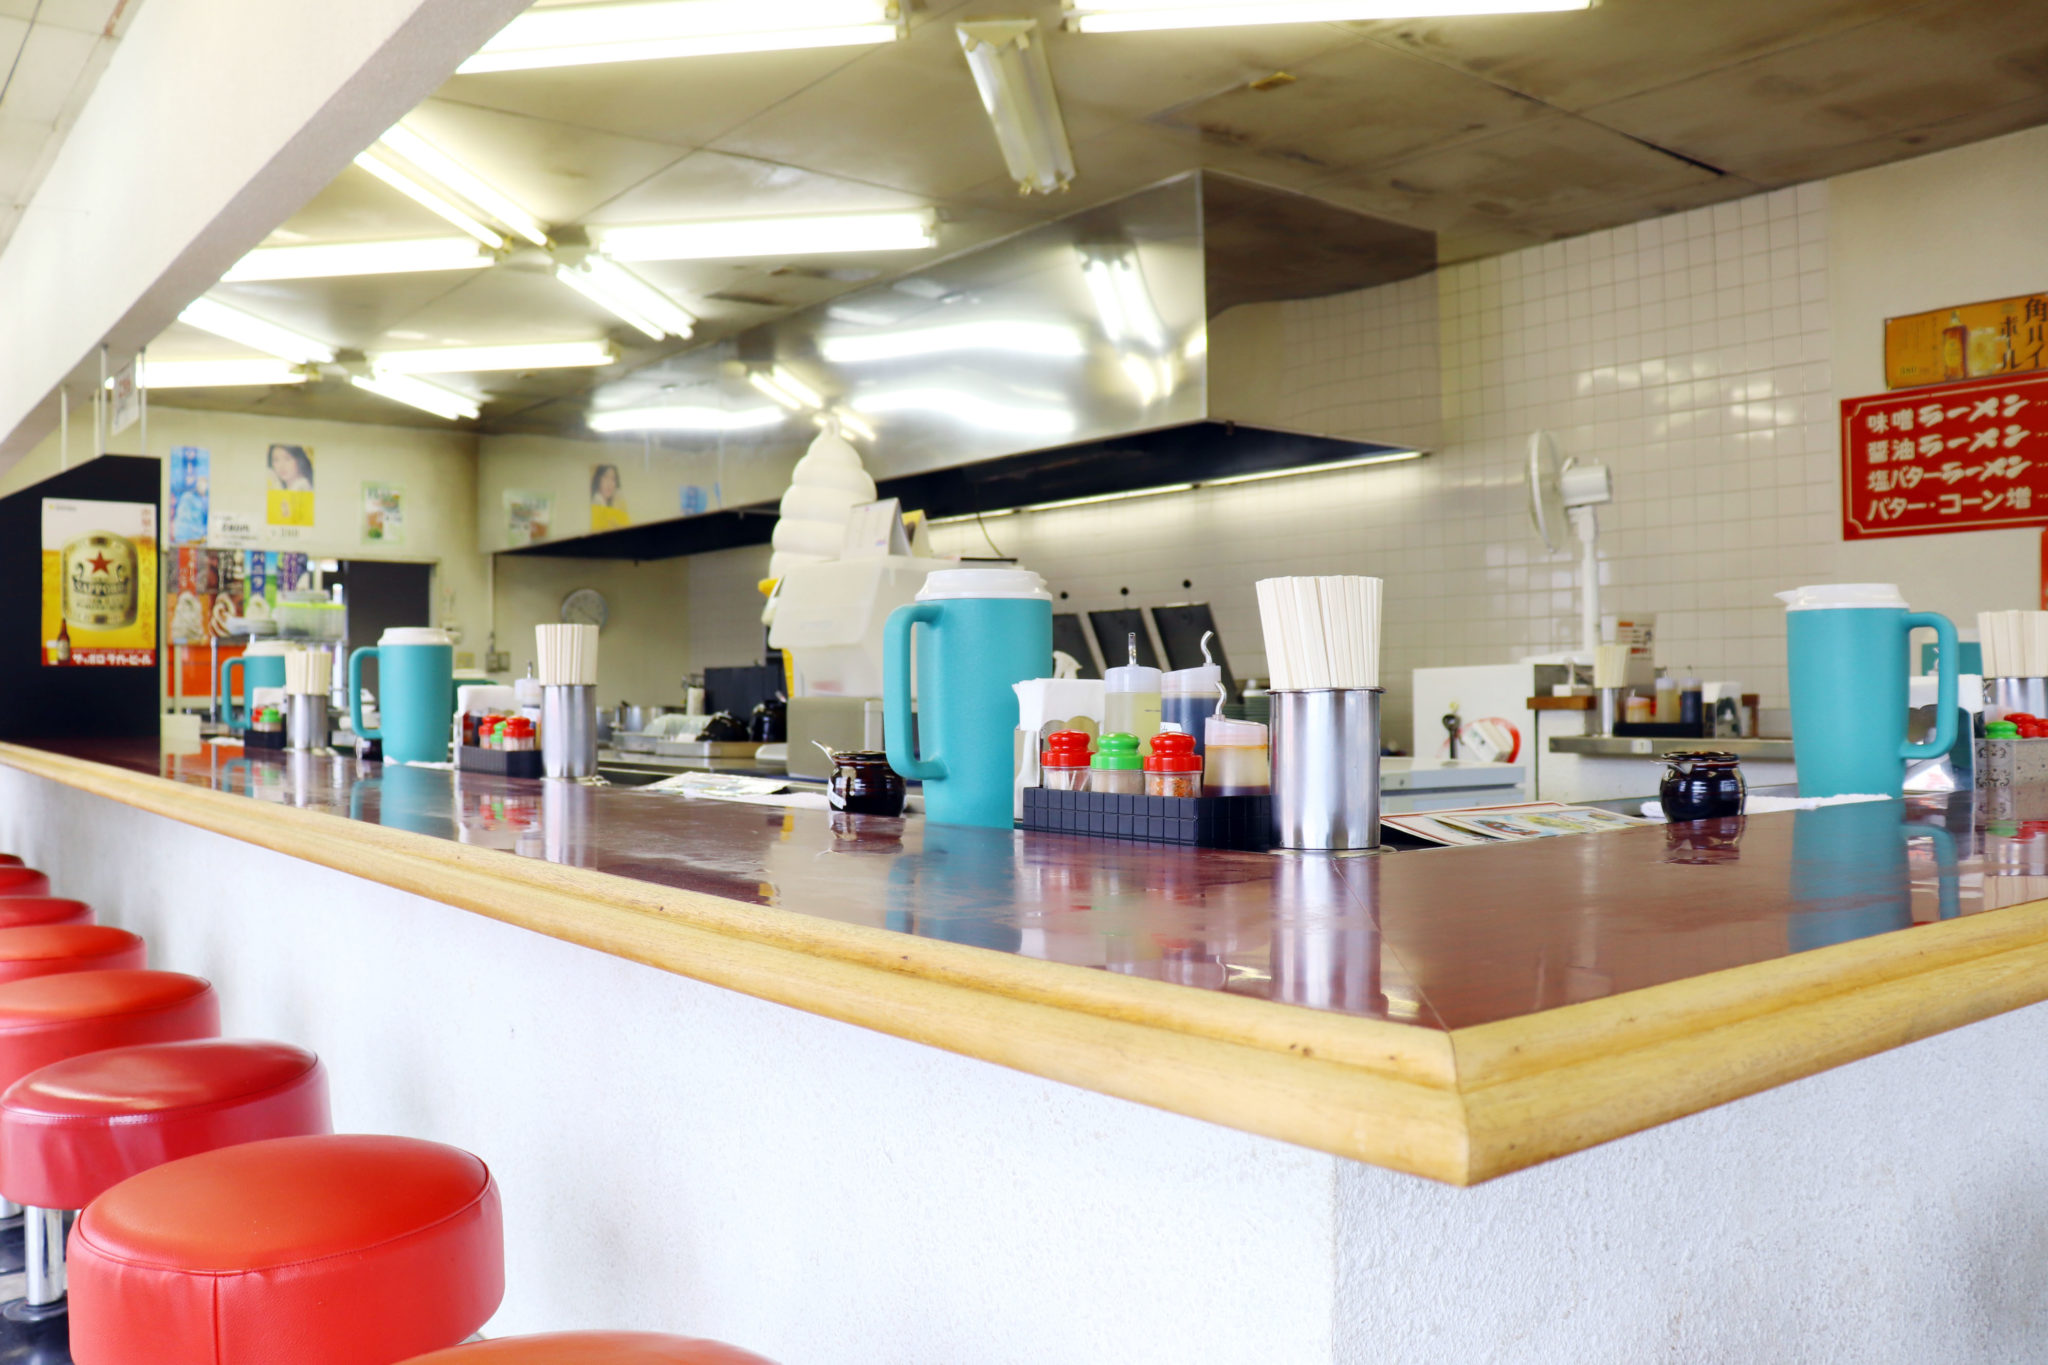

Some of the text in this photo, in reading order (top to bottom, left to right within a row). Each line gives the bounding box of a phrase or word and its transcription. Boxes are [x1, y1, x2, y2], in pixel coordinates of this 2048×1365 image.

[1867, 394, 2031, 434] 味噌ラーメン
[1867, 455, 2032, 492] 塩バターラーメン
[1867, 486, 2032, 521] バター・コーン増
